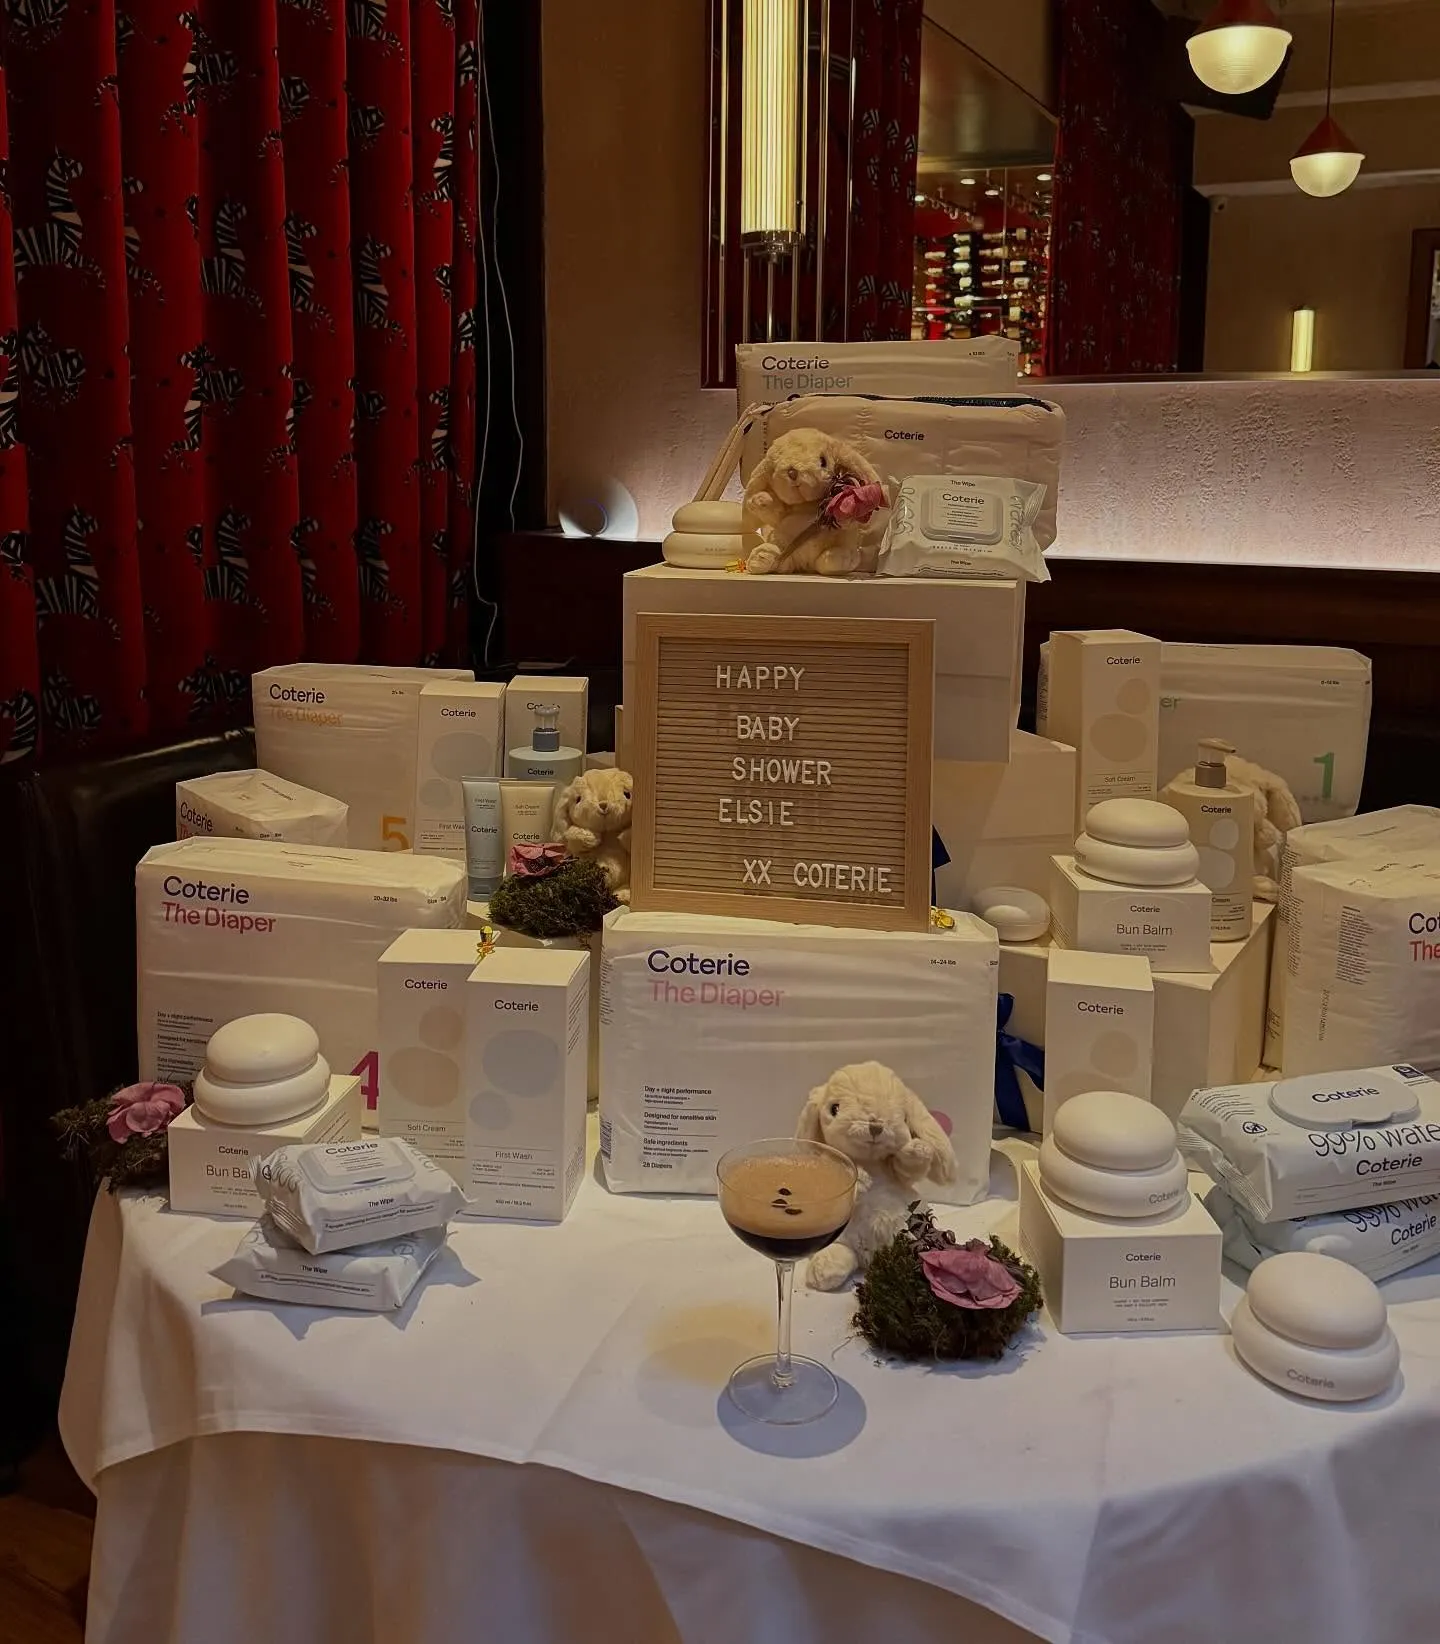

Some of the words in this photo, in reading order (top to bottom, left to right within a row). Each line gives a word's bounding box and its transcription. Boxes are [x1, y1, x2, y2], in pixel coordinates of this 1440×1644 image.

[762, 355, 830, 371] Coterie
[762, 374, 794, 390] The
[797, 373, 854, 392] Diaper
[884, 429, 925, 441] Coterie
[942, 493, 985, 505] Coterie
[1106, 656, 1141, 665] Coterie
[716, 664, 806, 691] HAPPY
[269, 683, 325, 704] Coterie
[270, 704, 293, 721] The
[296, 706, 343, 727] Diaper
[441, 708, 477, 718] Coterie
[736, 715, 801, 741] BABY
[527, 767, 554, 776] Coterie
[732, 756, 832, 786] SHOWER
[1313, 752, 1334, 799] 1
[718, 798, 795, 826] ELSIE
[1201, 805, 1232, 814] Coterie
[181, 802, 213, 832] Coterie
[383, 815, 410, 850] 5
[471, 825, 498, 834] Coterie
[512, 832, 540, 840] Coterie
[742, 858, 773, 885] XX
[793, 861, 892, 893] COTERIE
[163, 876, 250, 904] Coterie
[1130, 905, 1161, 913] Coterie
[162, 902, 200, 925] The
[205, 907, 277, 934] Diaper
[1116, 923, 1140, 935] Bun
[1143, 924, 1173, 936] Balm
[647, 949, 751, 976] Coterie
[404, 979, 448, 990] Coterie
[648, 979, 696, 1004] The
[700, 981, 785, 1010] Diaper
[494, 999, 539, 1012] Coterie
[1077, 1001, 1124, 1015] Coterie
[350, 1050, 379, 1111] 4
[644, 1085, 655, 1093] Day
[1311, 1086, 1381, 1104] Coterie
[644, 1111, 670, 1120] Designed
[422, 1124, 446, 1132] Cream
[643, 1137, 656, 1145] Safe
[1308, 1130, 1377, 1157] 99%
[218, 1145, 249, 1155] Coterie
[326, 1143, 379, 1155] Coterie
[512, 1151, 534, 1159] Wash
[206, 1164, 229, 1177] Bun
[1356, 1153, 1423, 1176] Coterie
[368, 1200, 379, 1208] The
[379, 1197, 395, 1205] Wipe
[1390, 1214, 1438, 1246] Coterie
[1125, 1252, 1162, 1262] Coterie
[301, 1264, 312, 1272] The
[1109, 1276, 1137, 1289] Bun
[1140, 1275, 1176, 1288] Balm
[1286, 1368, 1335, 1389] Coterie
